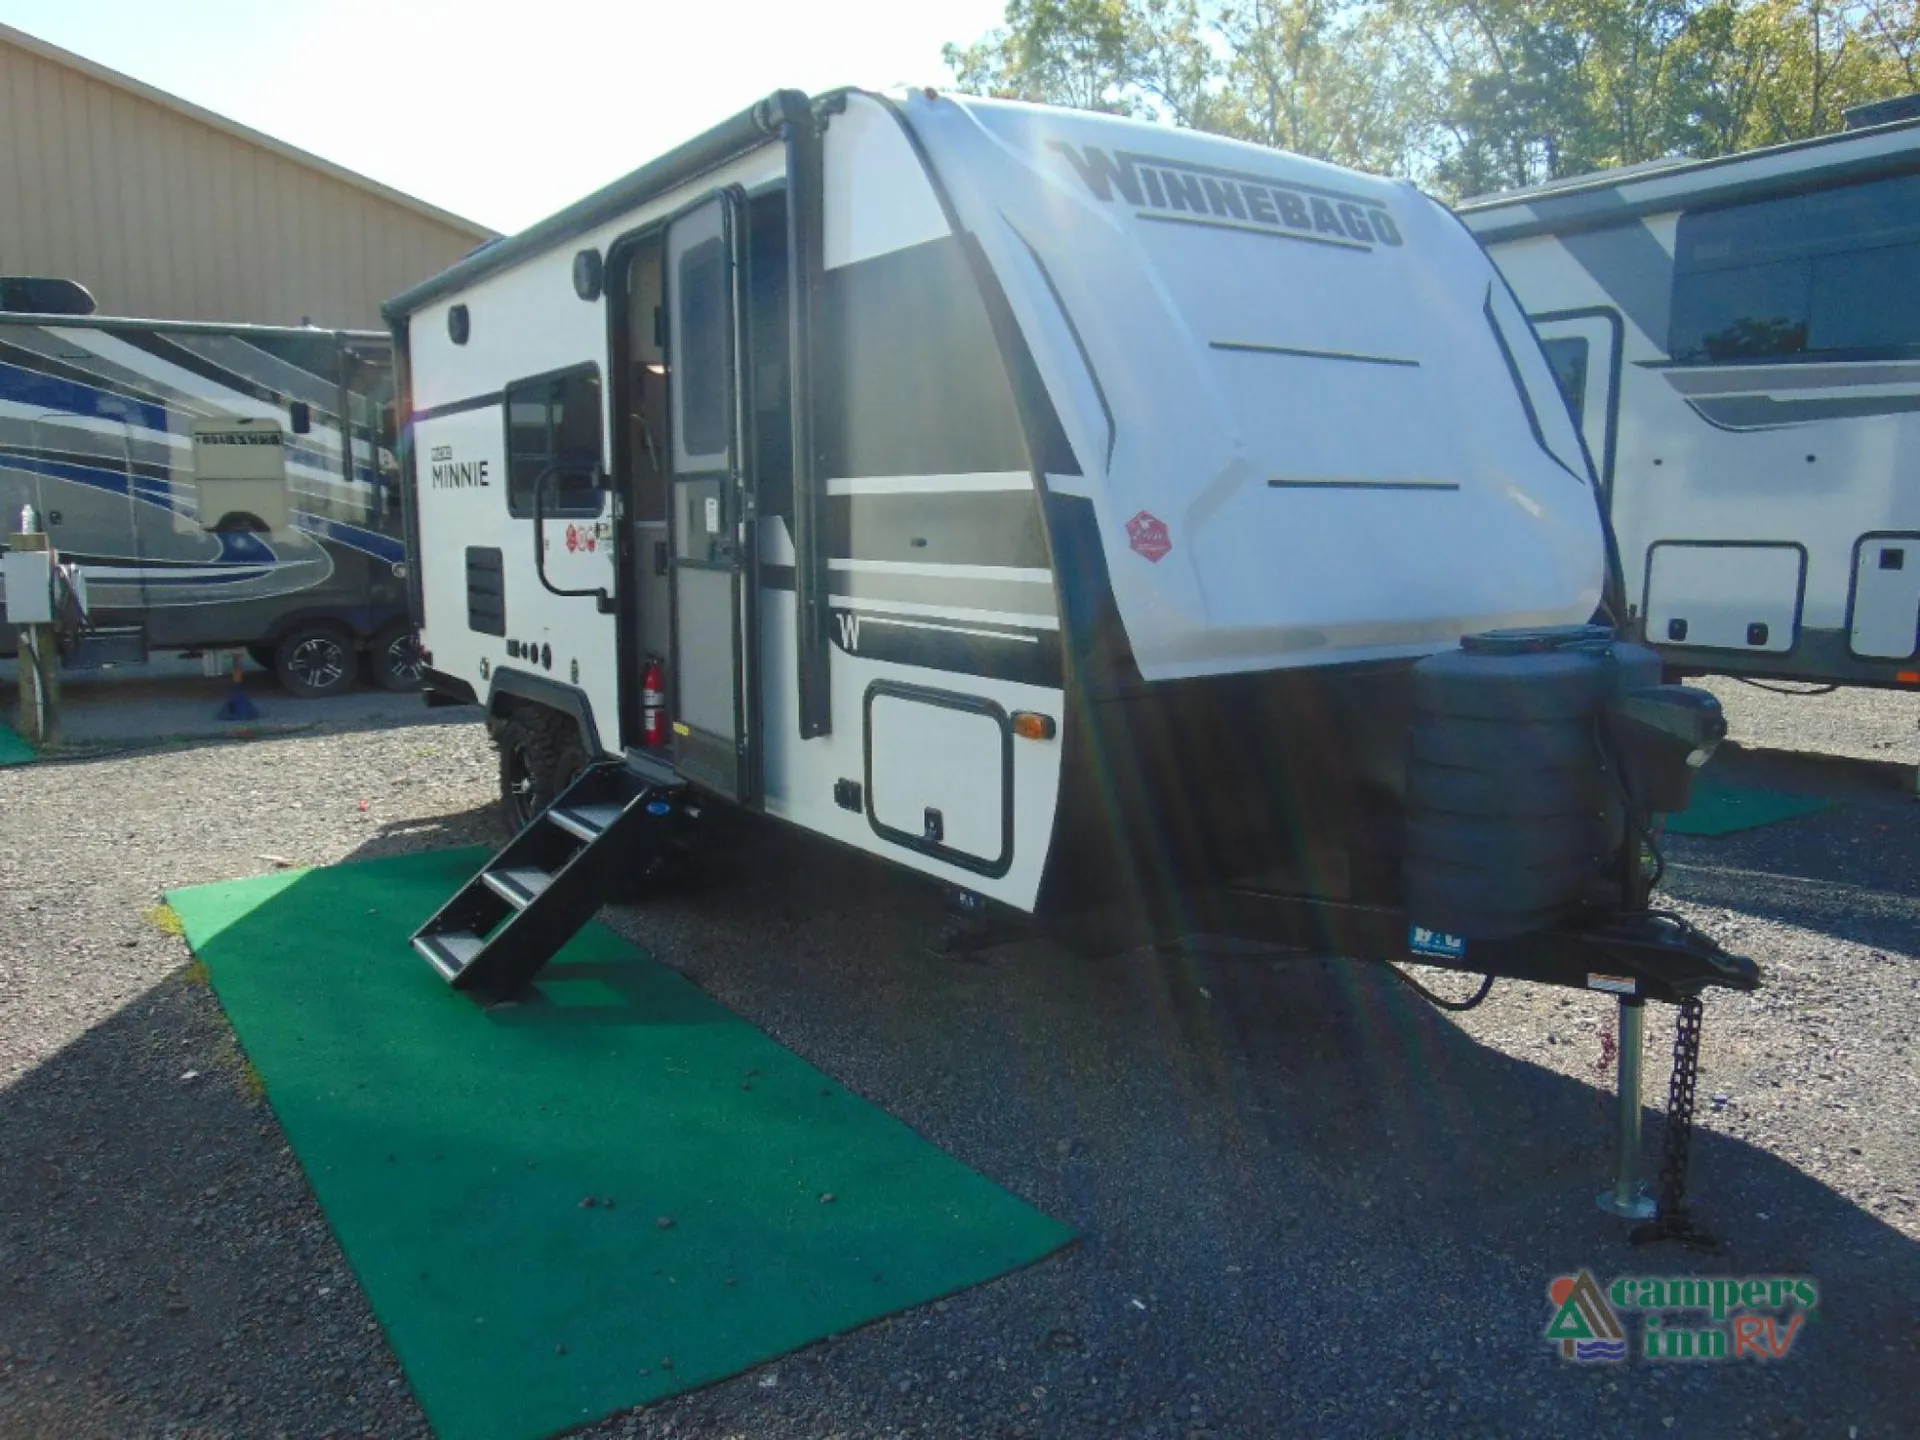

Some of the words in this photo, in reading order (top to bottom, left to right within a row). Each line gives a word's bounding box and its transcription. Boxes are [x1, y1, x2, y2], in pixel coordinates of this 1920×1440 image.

[1047, 139, 1403, 246] WINNEBAGO
[432, 461, 489, 489] MINNIE
[836, 613, 860, 650] W
